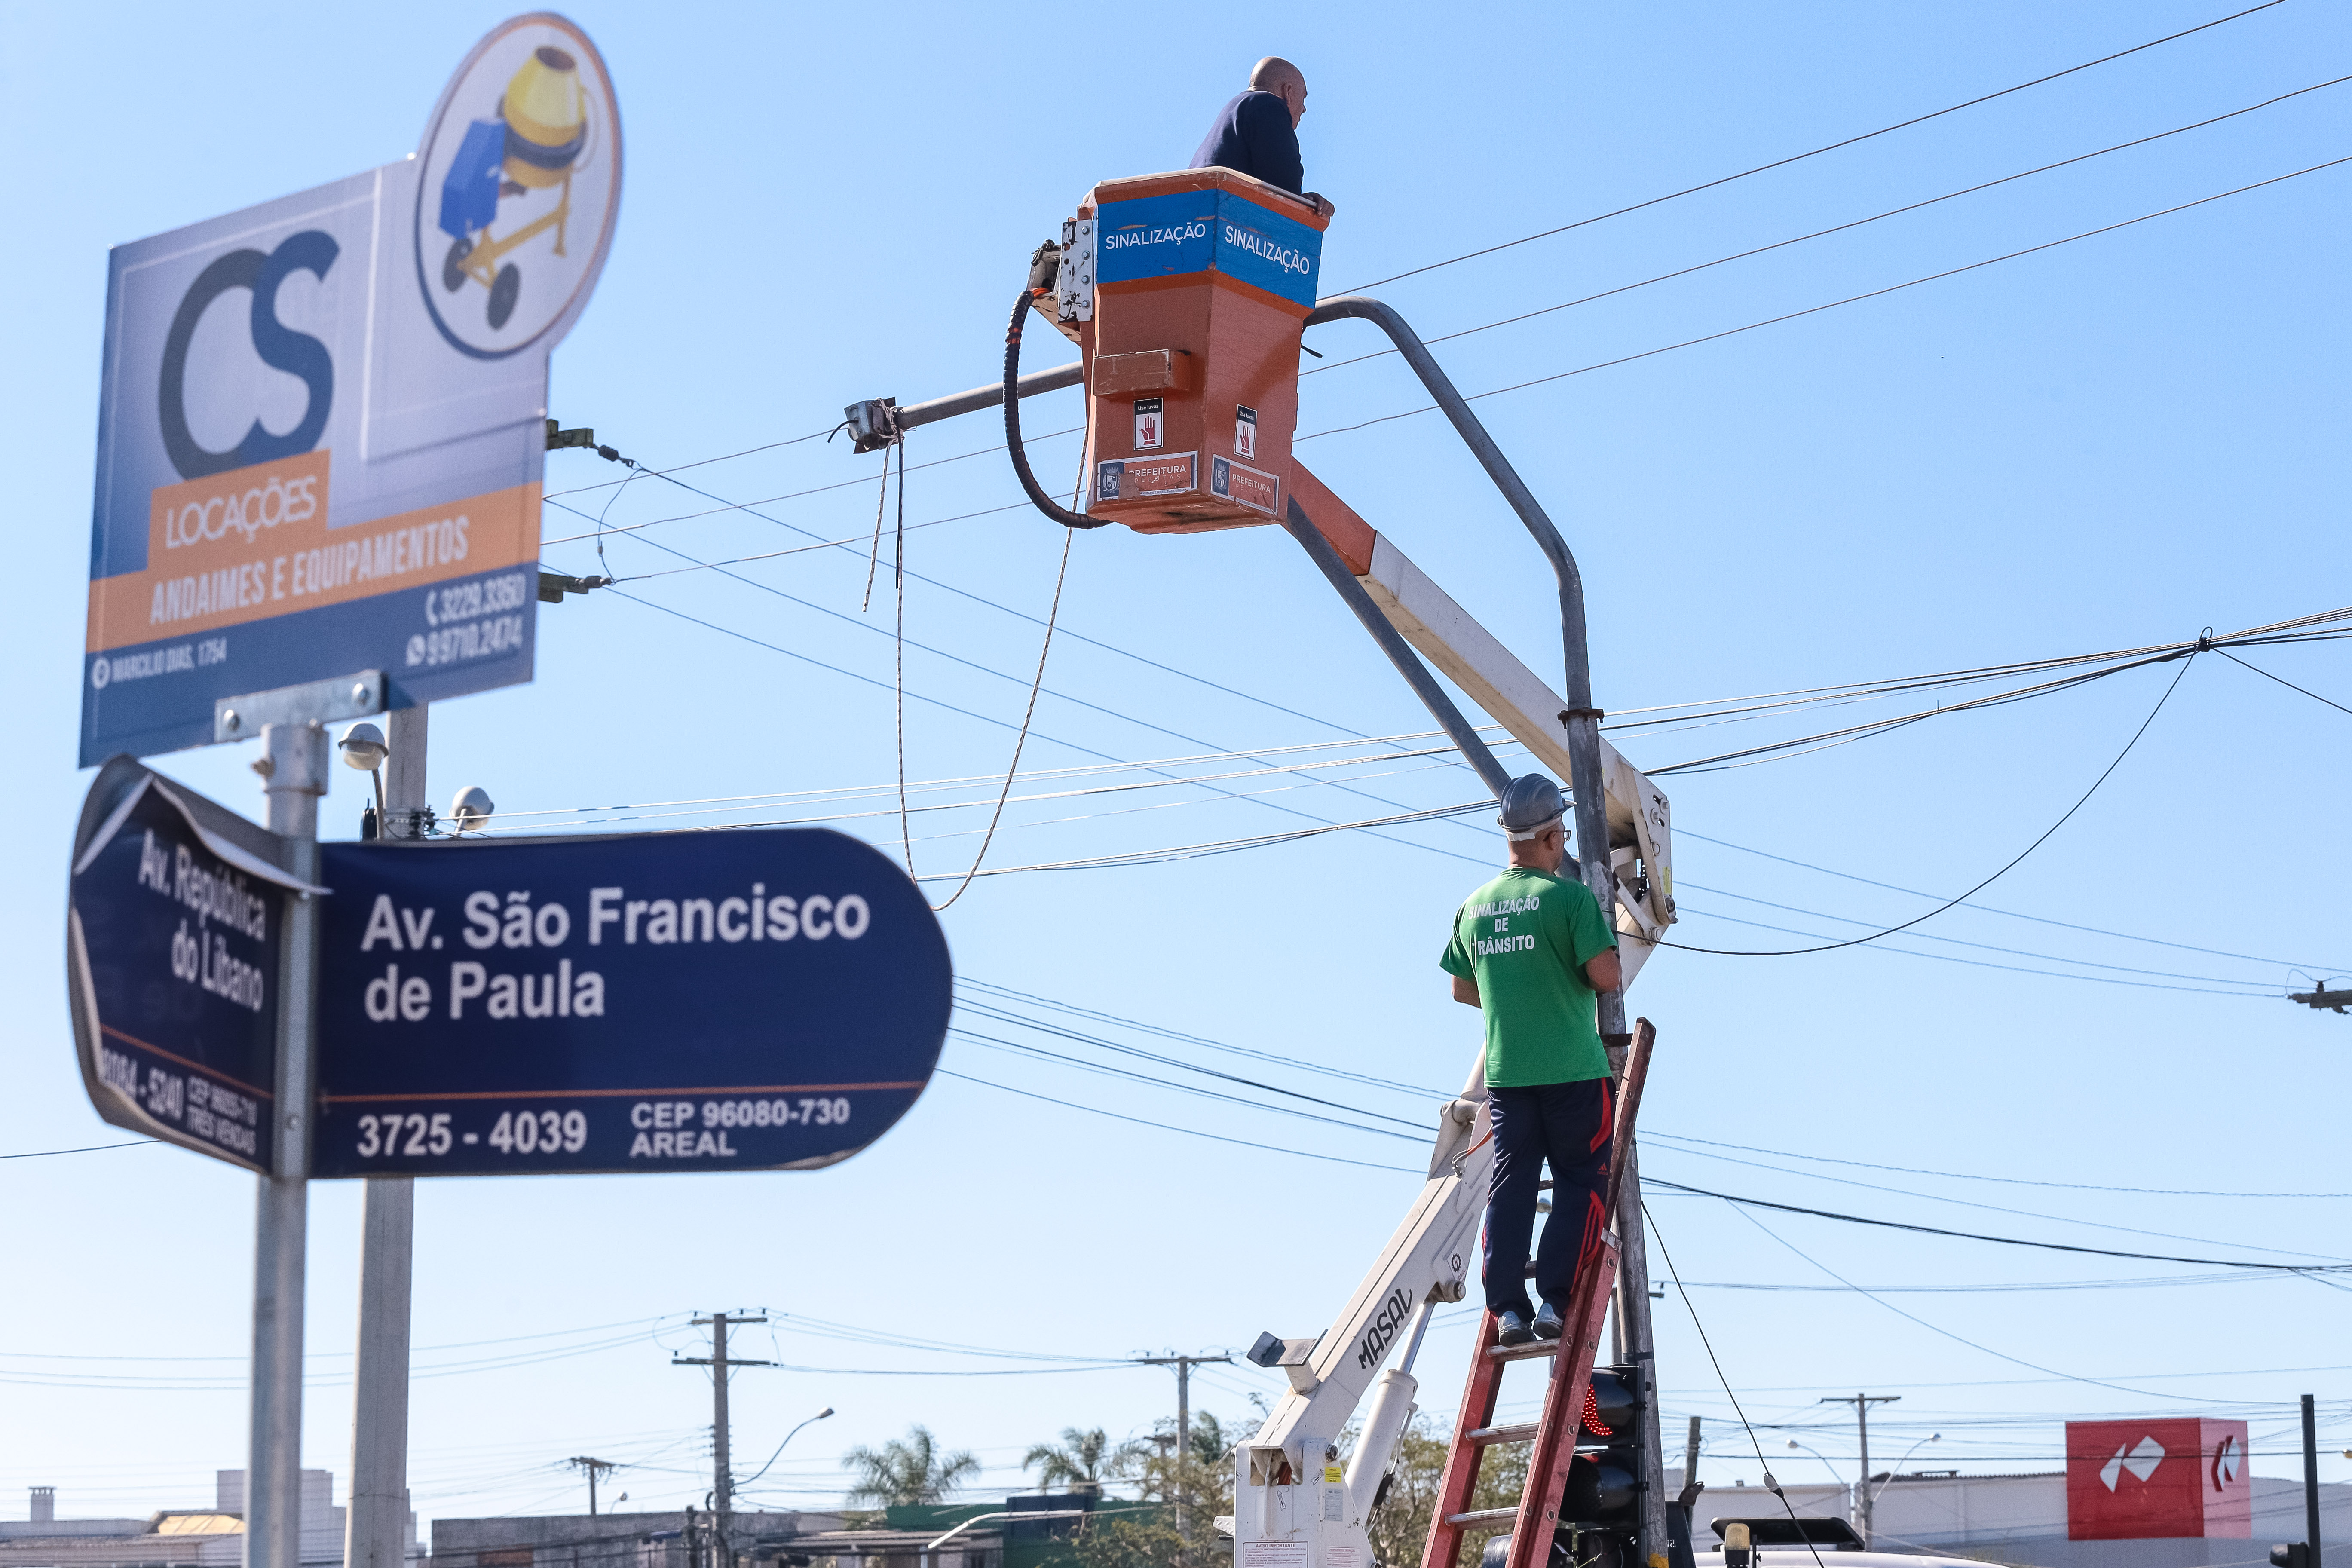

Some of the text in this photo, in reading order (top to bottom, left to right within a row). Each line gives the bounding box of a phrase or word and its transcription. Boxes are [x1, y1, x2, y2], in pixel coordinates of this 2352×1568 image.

[1106, 222, 1206, 250] SINALIZAÇÃO
[1225, 225, 1310, 275] SINALIZAÇÃO
[1232, 473, 1271, 493] PREFEITURA
[166, 475, 317, 549] LOCAÇÕES
[150, 515, 469, 625] ANDAIMES E EQUIPAMENTOS
[138, 827, 266, 942] Av. República
[1468, 894, 1540, 920] SINALIZAÇÃO
[360, 882, 871, 952] Av. São Francisco
[1494, 917, 1509, 933] DE
[172, 918, 199, 983] do
[364, 958, 606, 1022] de Paula
[356, 1109, 588, 1158] 3725 - 4039
[630, 1096, 851, 1130] CEP 96080-730
[629, 1130, 738, 1158] AREAL
[1357, 1288, 1413, 1369] MASAL
